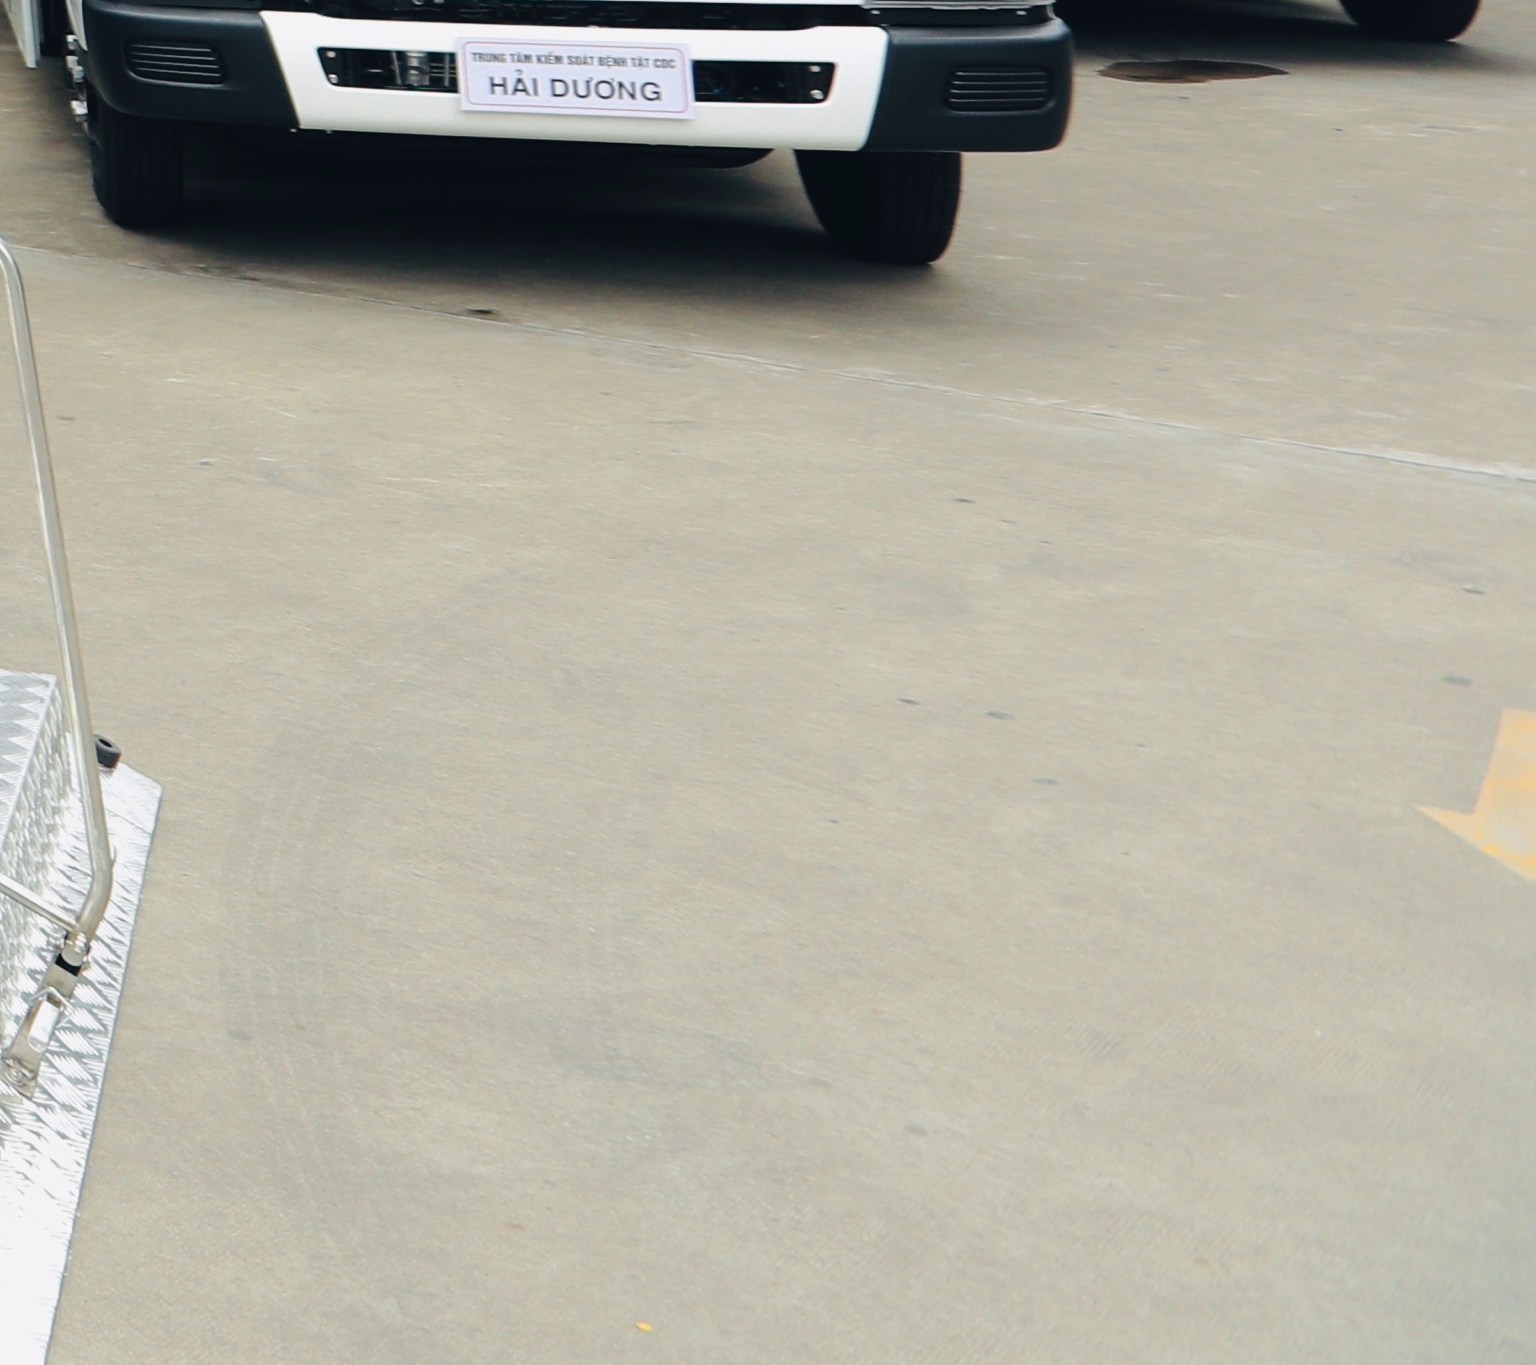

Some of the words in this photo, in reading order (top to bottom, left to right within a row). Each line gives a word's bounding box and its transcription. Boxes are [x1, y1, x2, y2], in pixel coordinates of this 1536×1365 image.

[472, 52, 507, 63] TRUNG
[510, 50, 534, 64] TÂM
[536, 51, 565, 65] KIỂM
[567, 53, 595, 66] SOÁT
[598, 55, 628, 69] BỆNH
[630, 56, 651, 70] TẬT
[654, 58, 676, 69] CDC
[489, 69, 539, 97] HẢI
[550, 77, 663, 101] DƯƠNG
